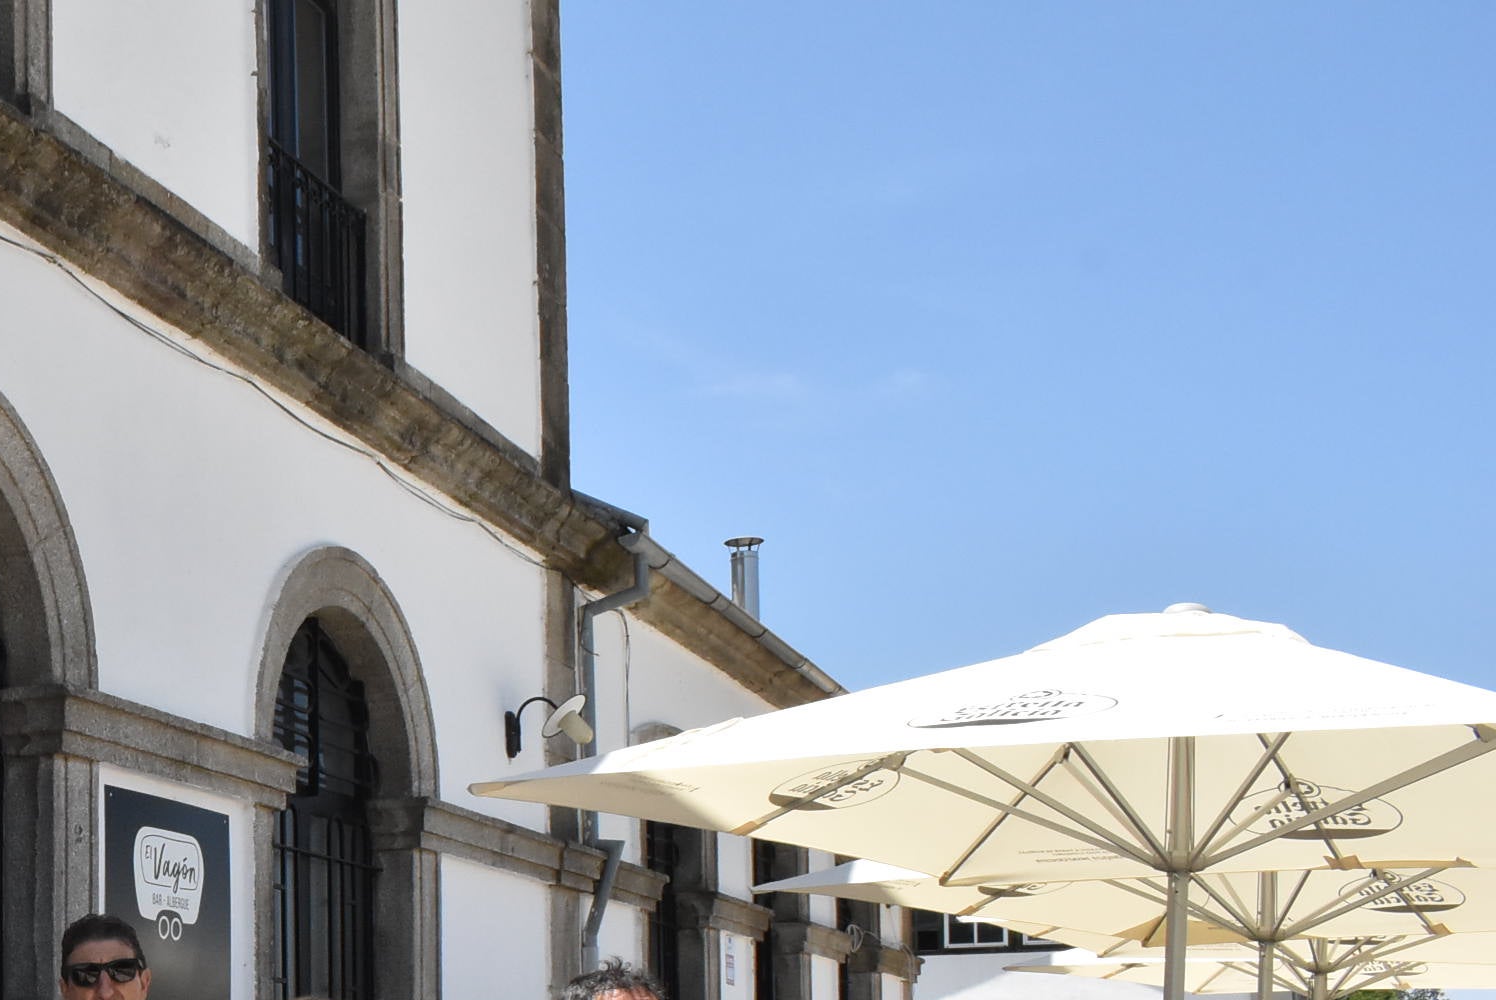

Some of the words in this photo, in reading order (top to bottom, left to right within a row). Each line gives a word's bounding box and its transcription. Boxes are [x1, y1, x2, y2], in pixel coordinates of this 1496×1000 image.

[145, 844, 153, 860] El
[153, 843, 197, 893] Vagón
[152, 892, 162, 906] BAR
